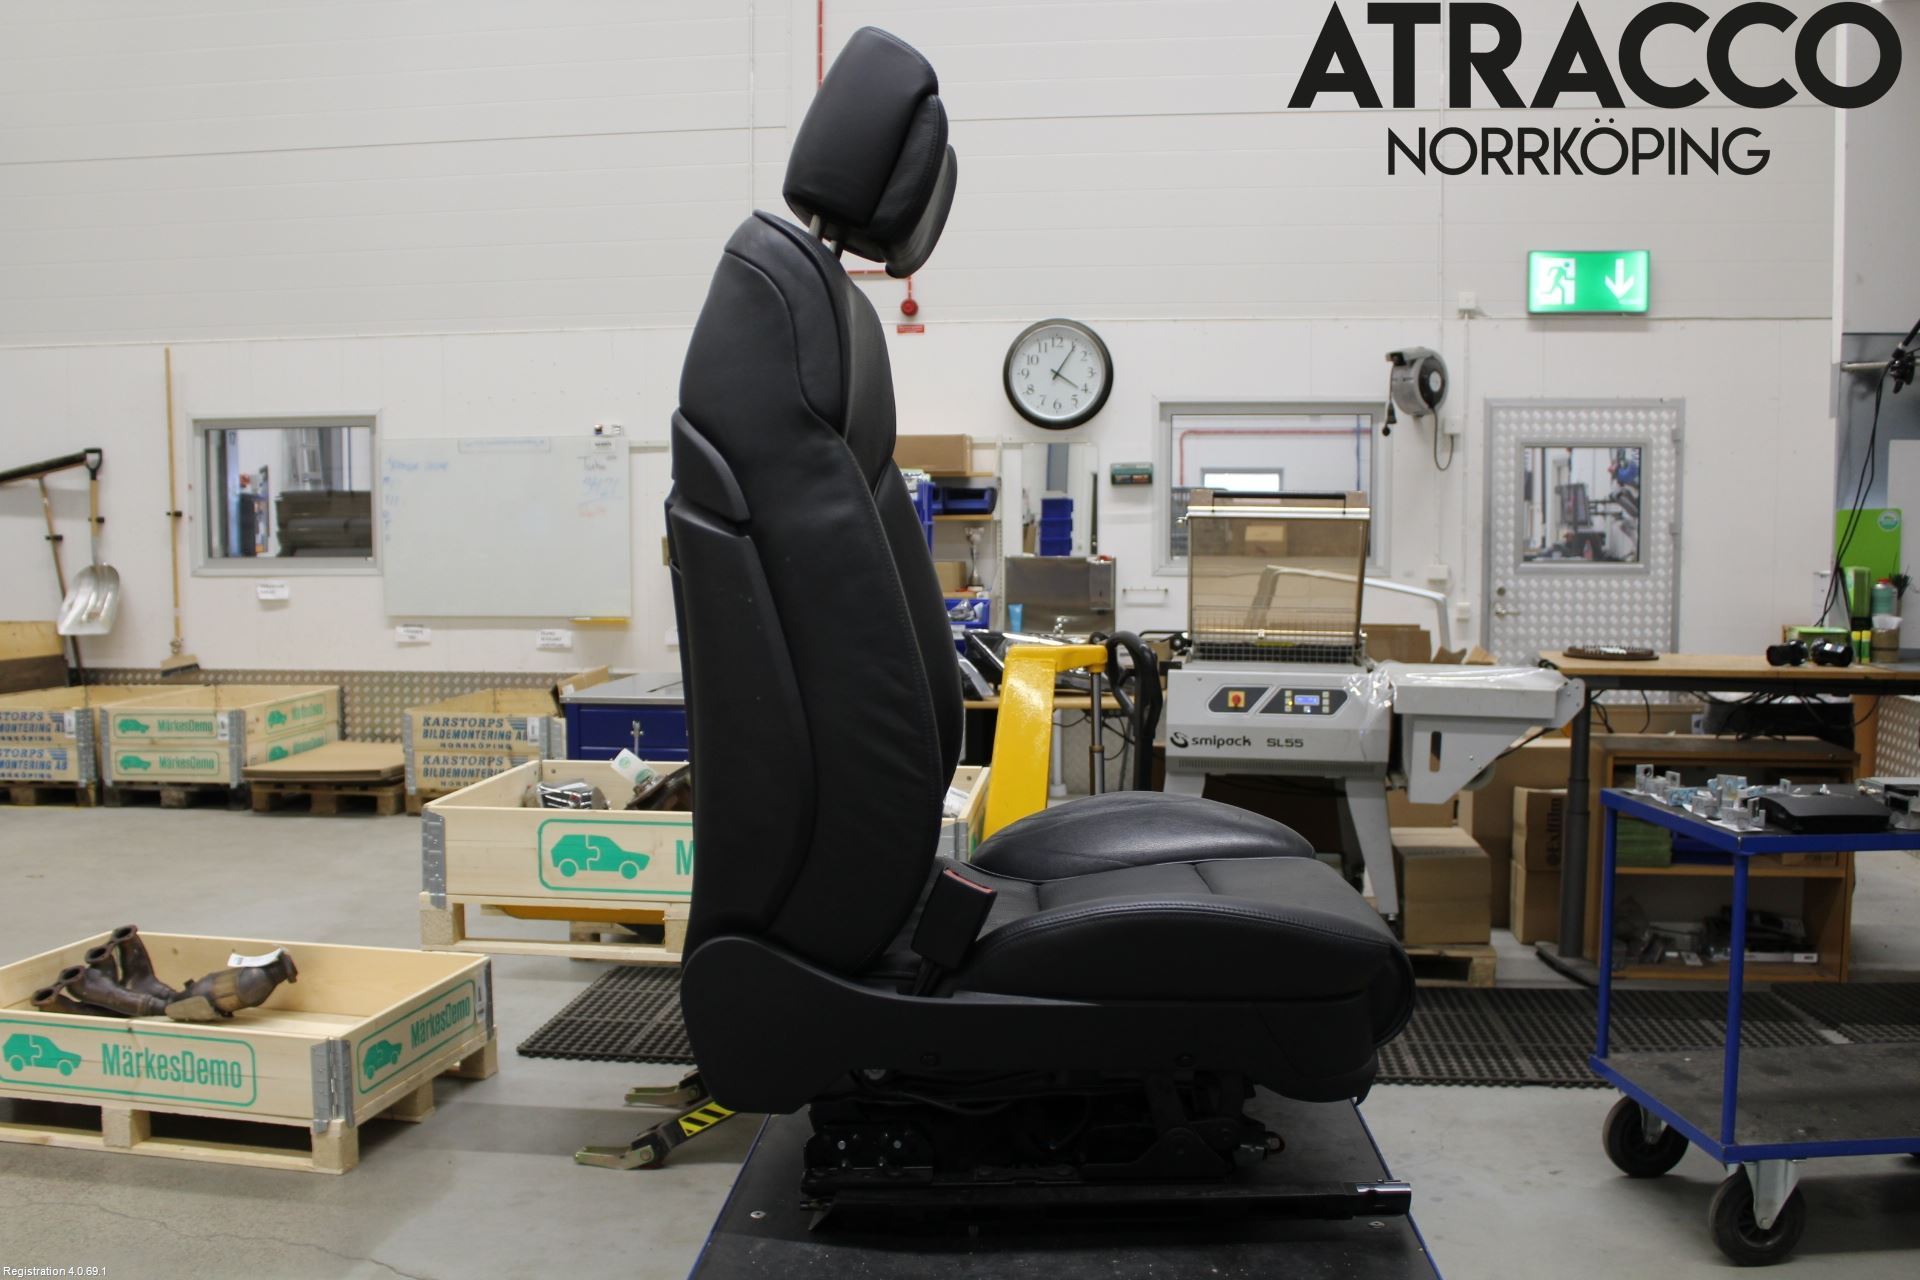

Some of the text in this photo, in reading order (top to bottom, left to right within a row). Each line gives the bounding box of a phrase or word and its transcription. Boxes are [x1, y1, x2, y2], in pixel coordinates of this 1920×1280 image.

[1038, 342, 1048, 353] 11
[1051, 336, 1064, 348] 12
[1026, 354, 1039, 365] 10
[1080, 350, 1088, 361] 2
[1021, 368, 1030, 378] 9
[1088, 367, 1094, 378] 3
[1026, 384, 1035, 395] 8
[1080, 383, 1088, 393] 4
[1040, 394, 1047, 405] 7
[1053, 398, 1062, 409] 6
[1071, 394, 1079, 408] 5
[422, 717, 504, 728] KARSTORPS
[422, 729, 512, 741] BILDEMONTERING
[1191, 735, 1304, 749] smipack SL55
[422, 755, 504, 766] KARSTORPS
[411, 996, 470, 1049] MärkesDemo
[101, 1043, 242, 1089] MärkesDemo
